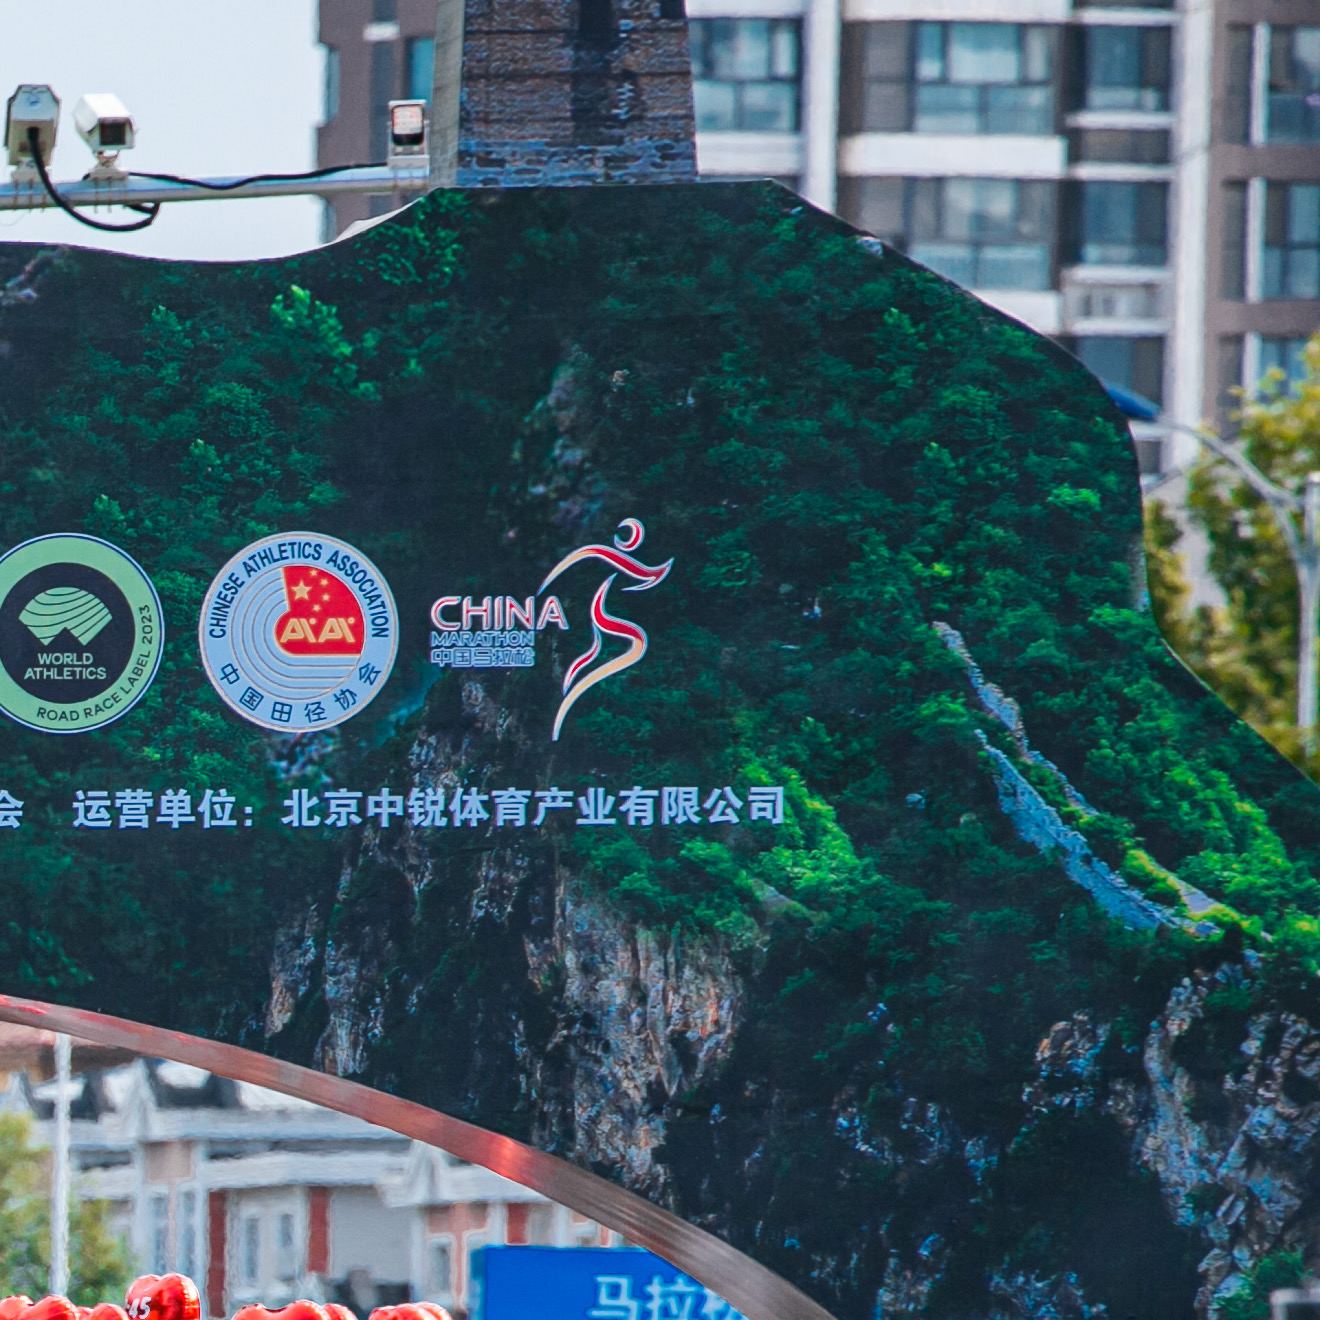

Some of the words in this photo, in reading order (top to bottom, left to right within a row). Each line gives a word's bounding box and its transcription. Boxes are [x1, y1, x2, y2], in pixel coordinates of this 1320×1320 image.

[208, 574, 243, 639] CHINESE
[242, 541, 323, 578] ATHLETICS
[326, 549, 389, 639] ASSOCIATION
[430, 595, 570, 631] CHINA
[430, 630, 535, 647] MARATHON
[24, 667, 107, 680] ATHLETICS
[36, 707, 80, 723] ROAD
[84, 695, 123, 719] RACE
[122, 648, 150, 698] LABEL
[140, 604, 154, 645] 2023
[37, 653, 94, 666] WORLD
[218, 661, 381, 724] 中国田径协会
